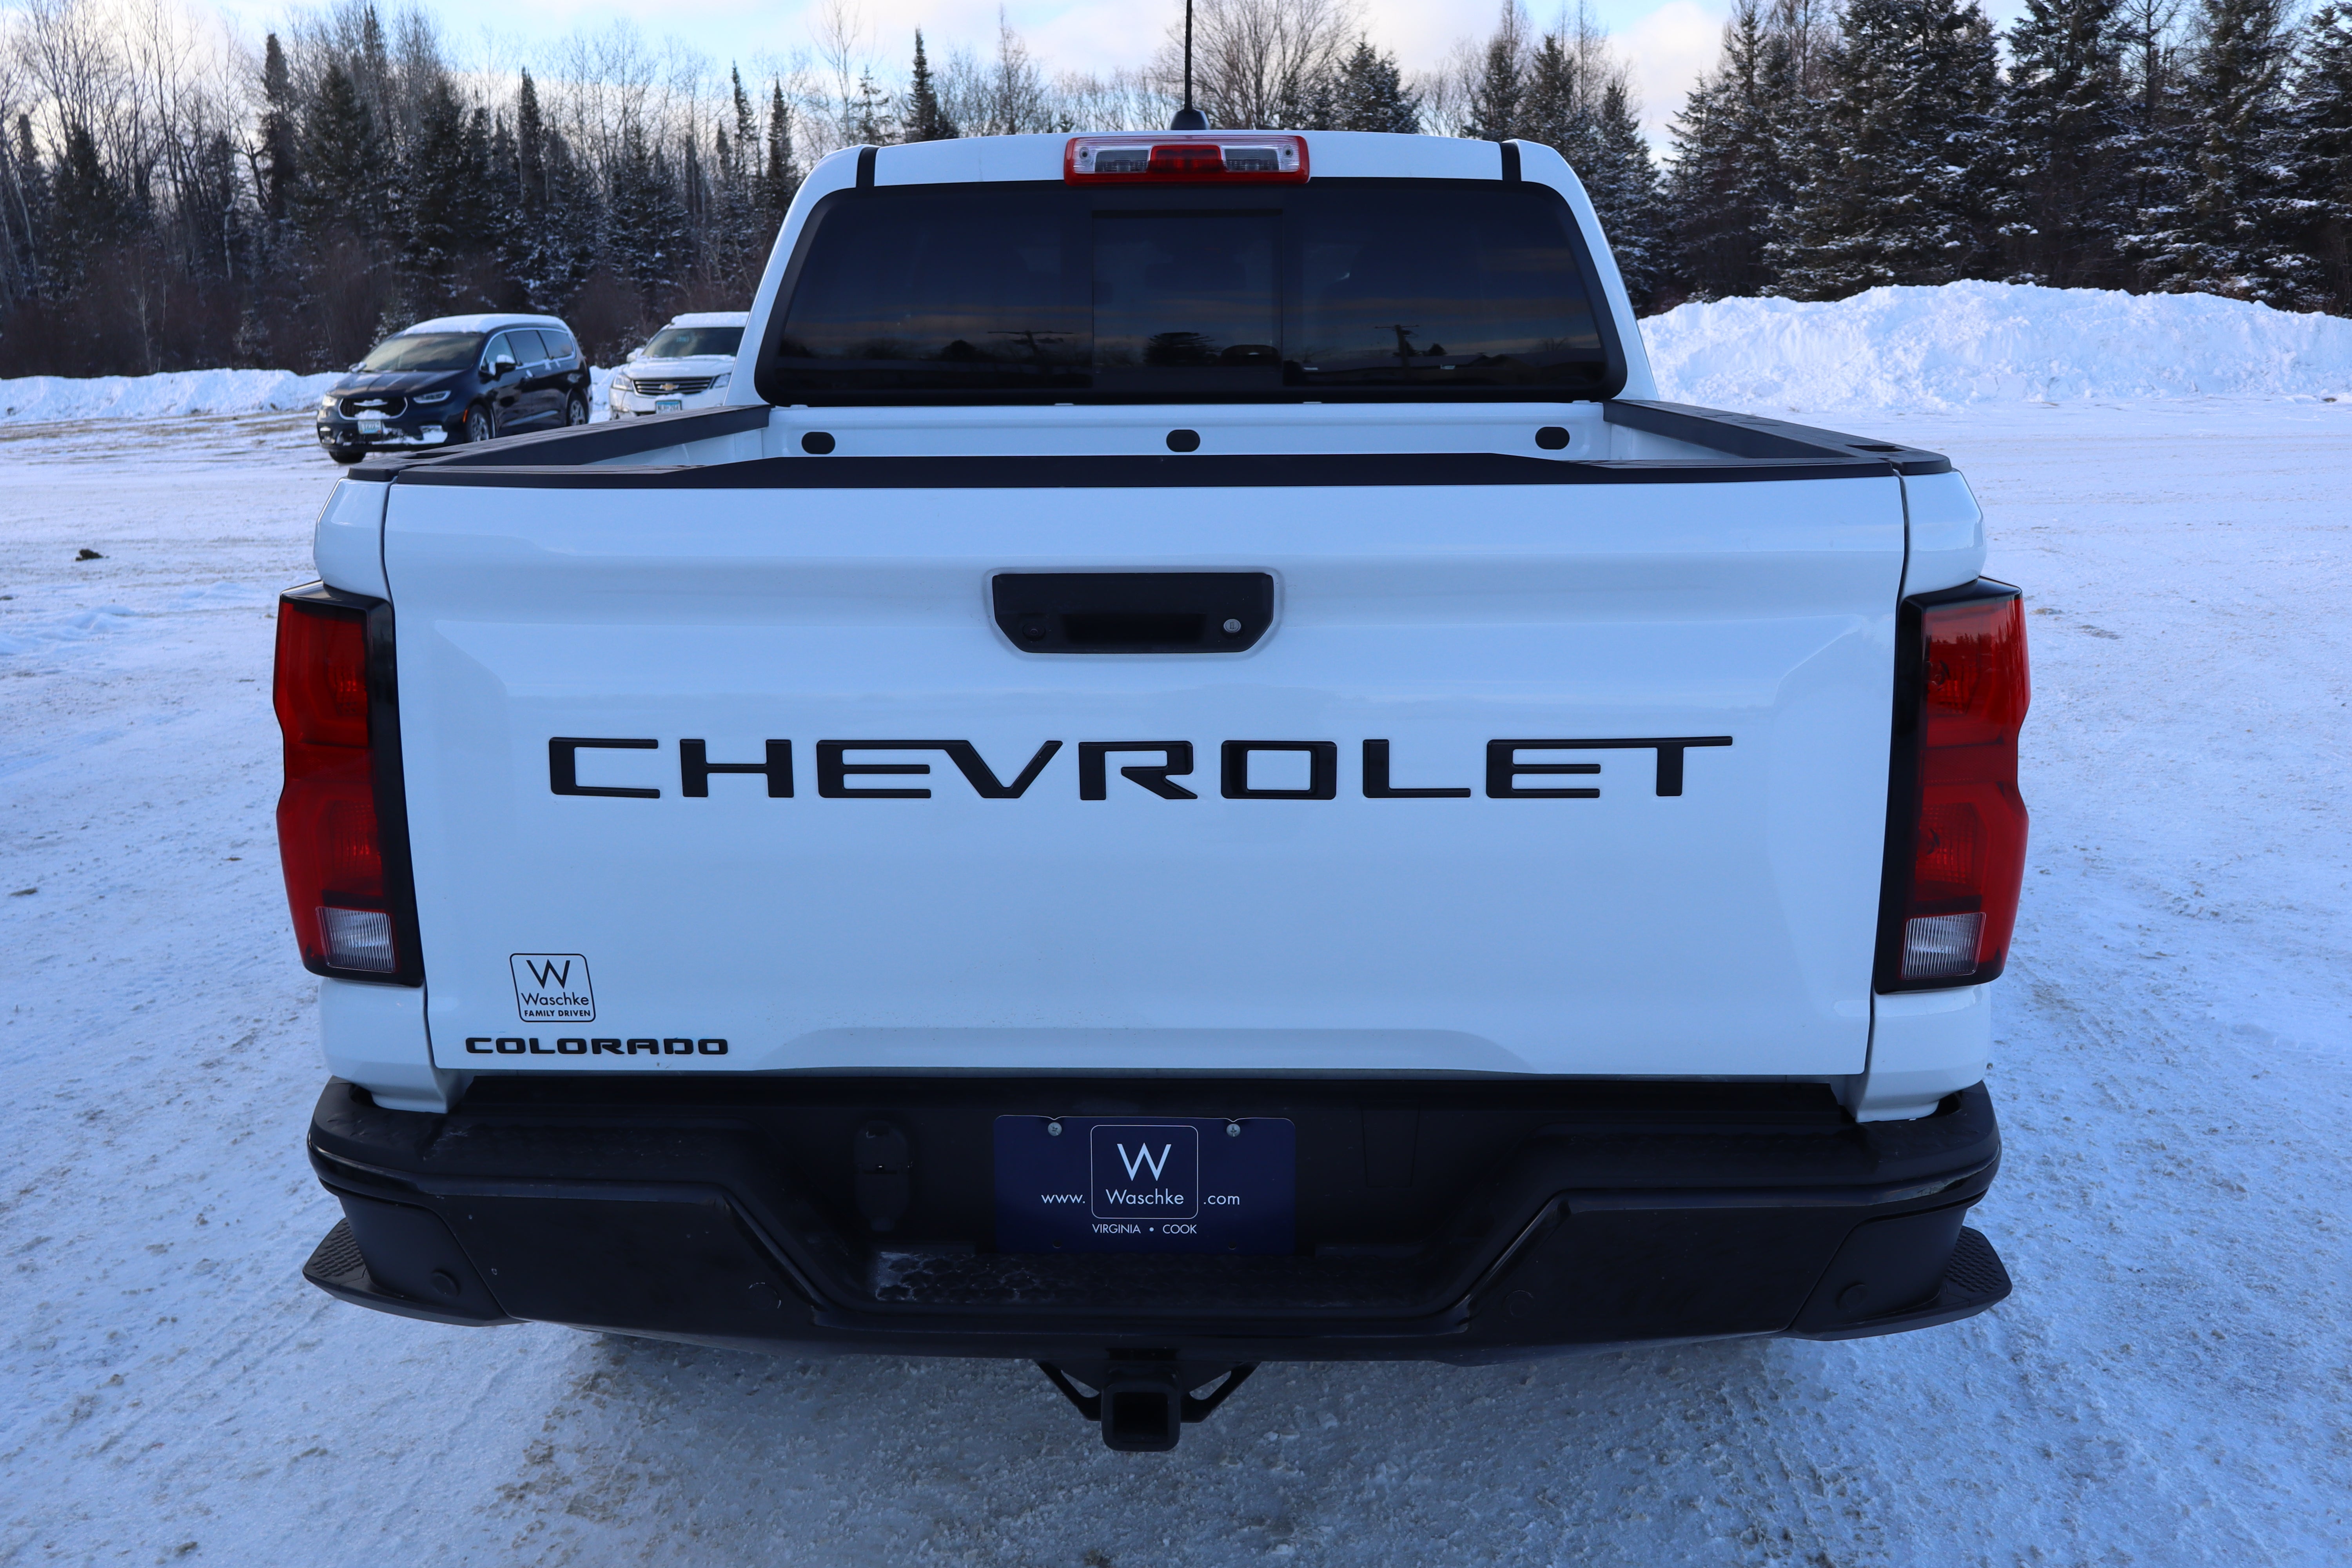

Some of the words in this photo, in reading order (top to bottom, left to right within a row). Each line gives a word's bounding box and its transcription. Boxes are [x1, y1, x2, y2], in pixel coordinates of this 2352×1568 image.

[549, 736, 1733, 800] CHEVROLET
[526, 959, 570, 989] W
[521, 992, 589, 1006] Waschke
[465, 1038, 728, 1055] COLORADO
[1117, 1143, 1171, 1181] W
[1041, 1194, 1086, 1204] www.
[1105, 1189, 1184, 1205] Waschke
[1203, 1195, 1240, 1205] .com
[1092, 1224, 1141, 1234] VIRGINIA
[1162, 1224, 1197, 1234] COOK
